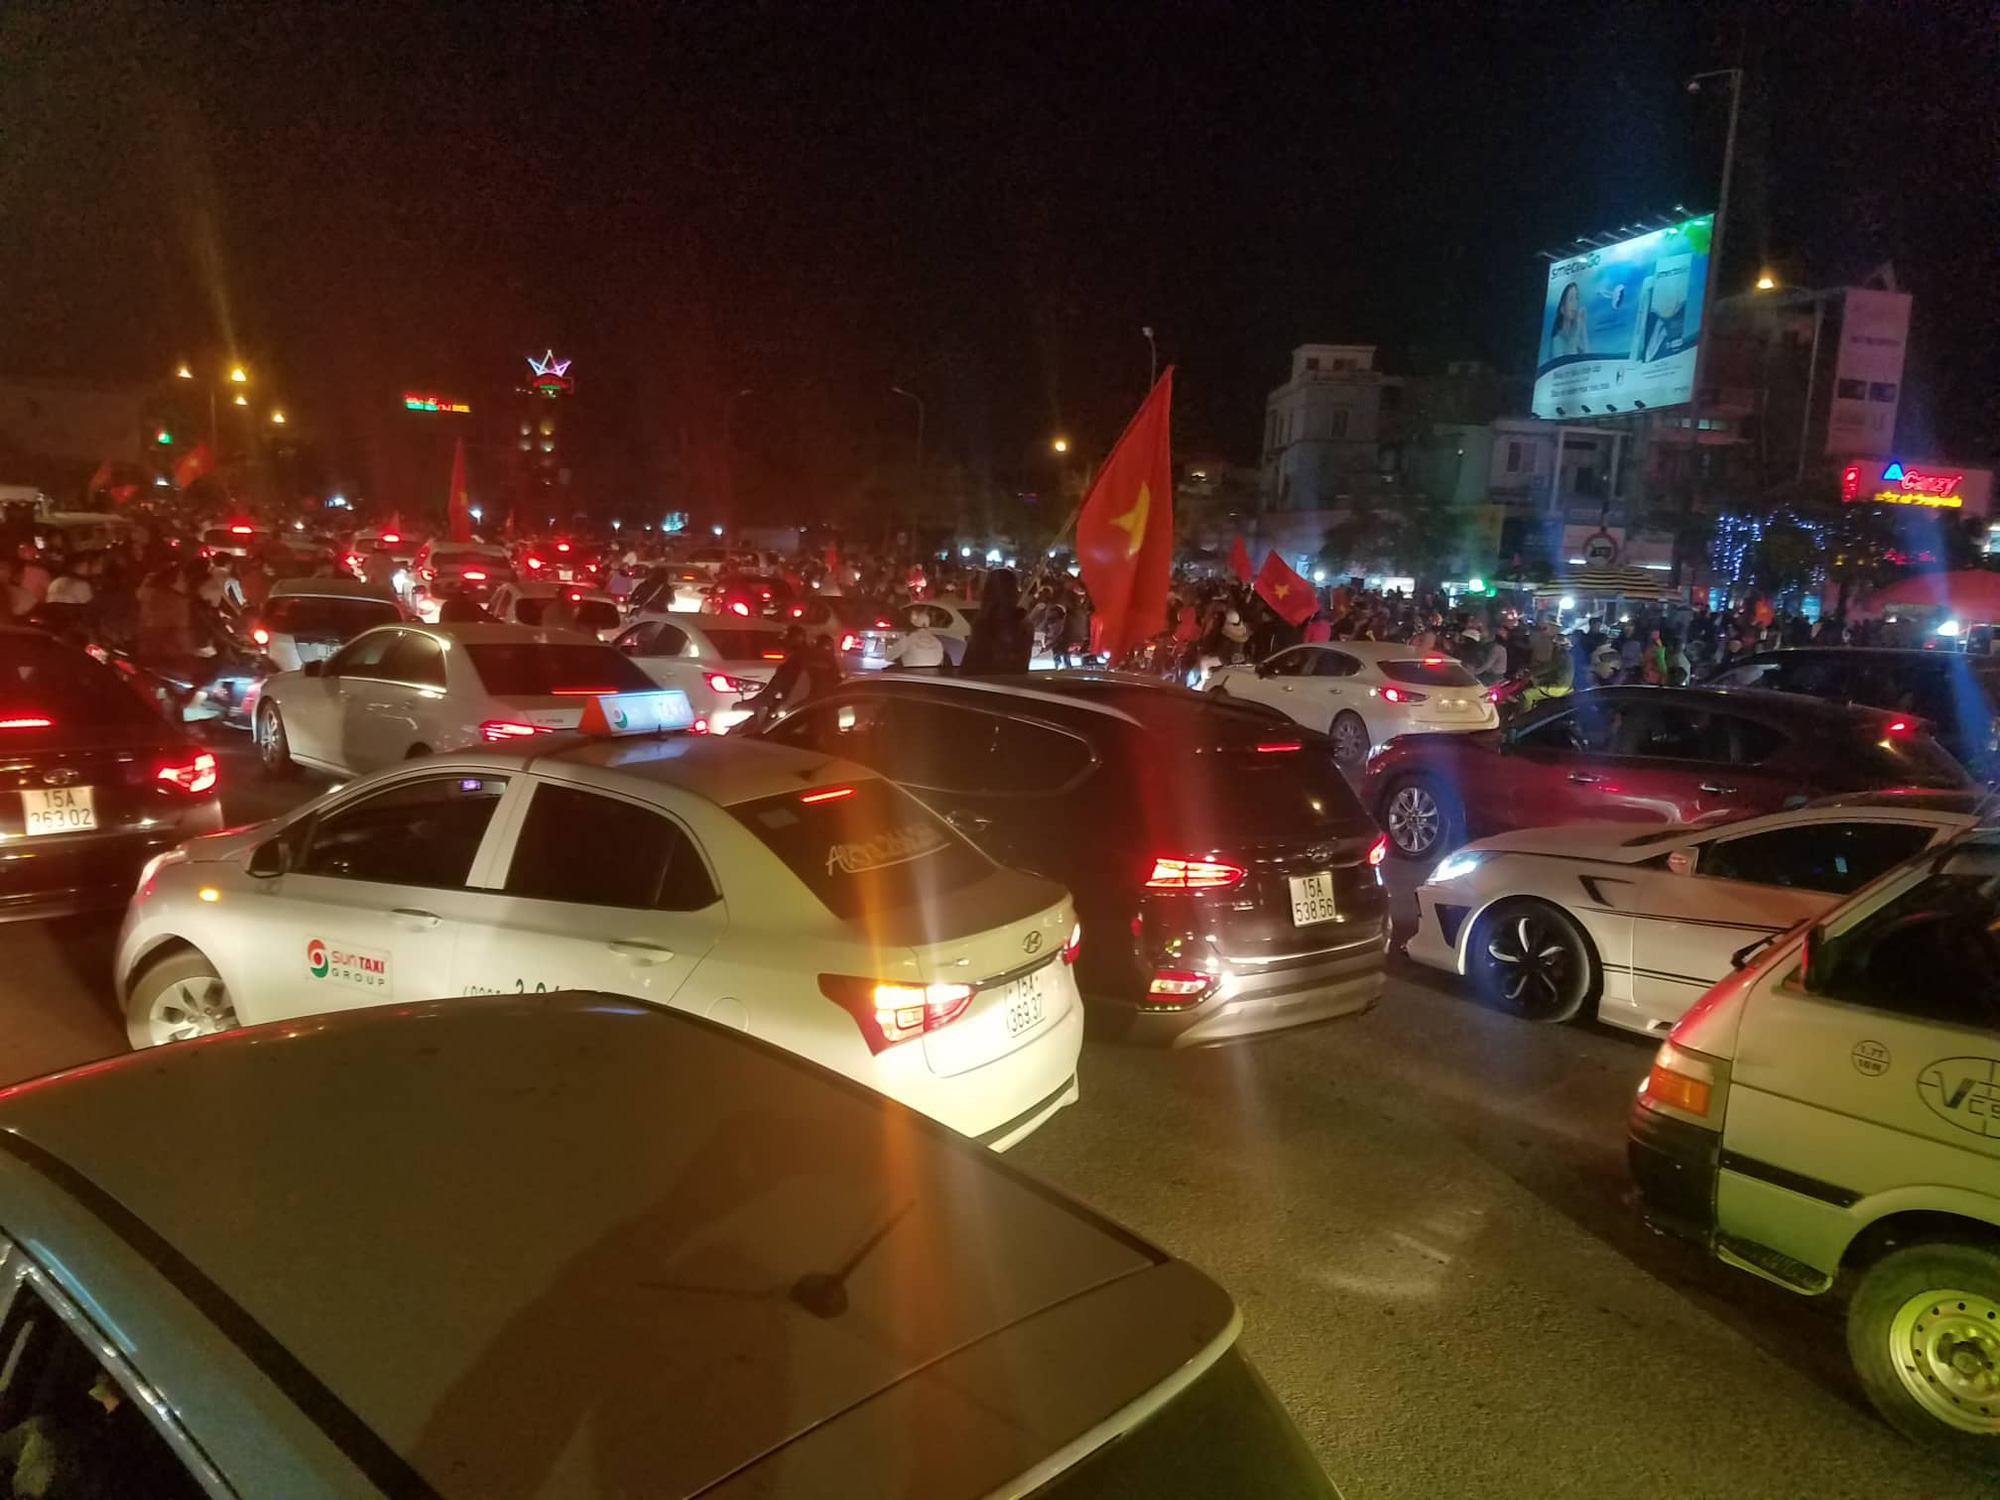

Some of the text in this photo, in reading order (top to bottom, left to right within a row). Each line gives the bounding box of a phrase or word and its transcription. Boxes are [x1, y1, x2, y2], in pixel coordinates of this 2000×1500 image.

[43, 789, 76, 808] 15A
[1302, 877, 1324, 898] 15A
[358, 956, 385, 974] TAXI
[331, 967, 385, 986] GROUP
